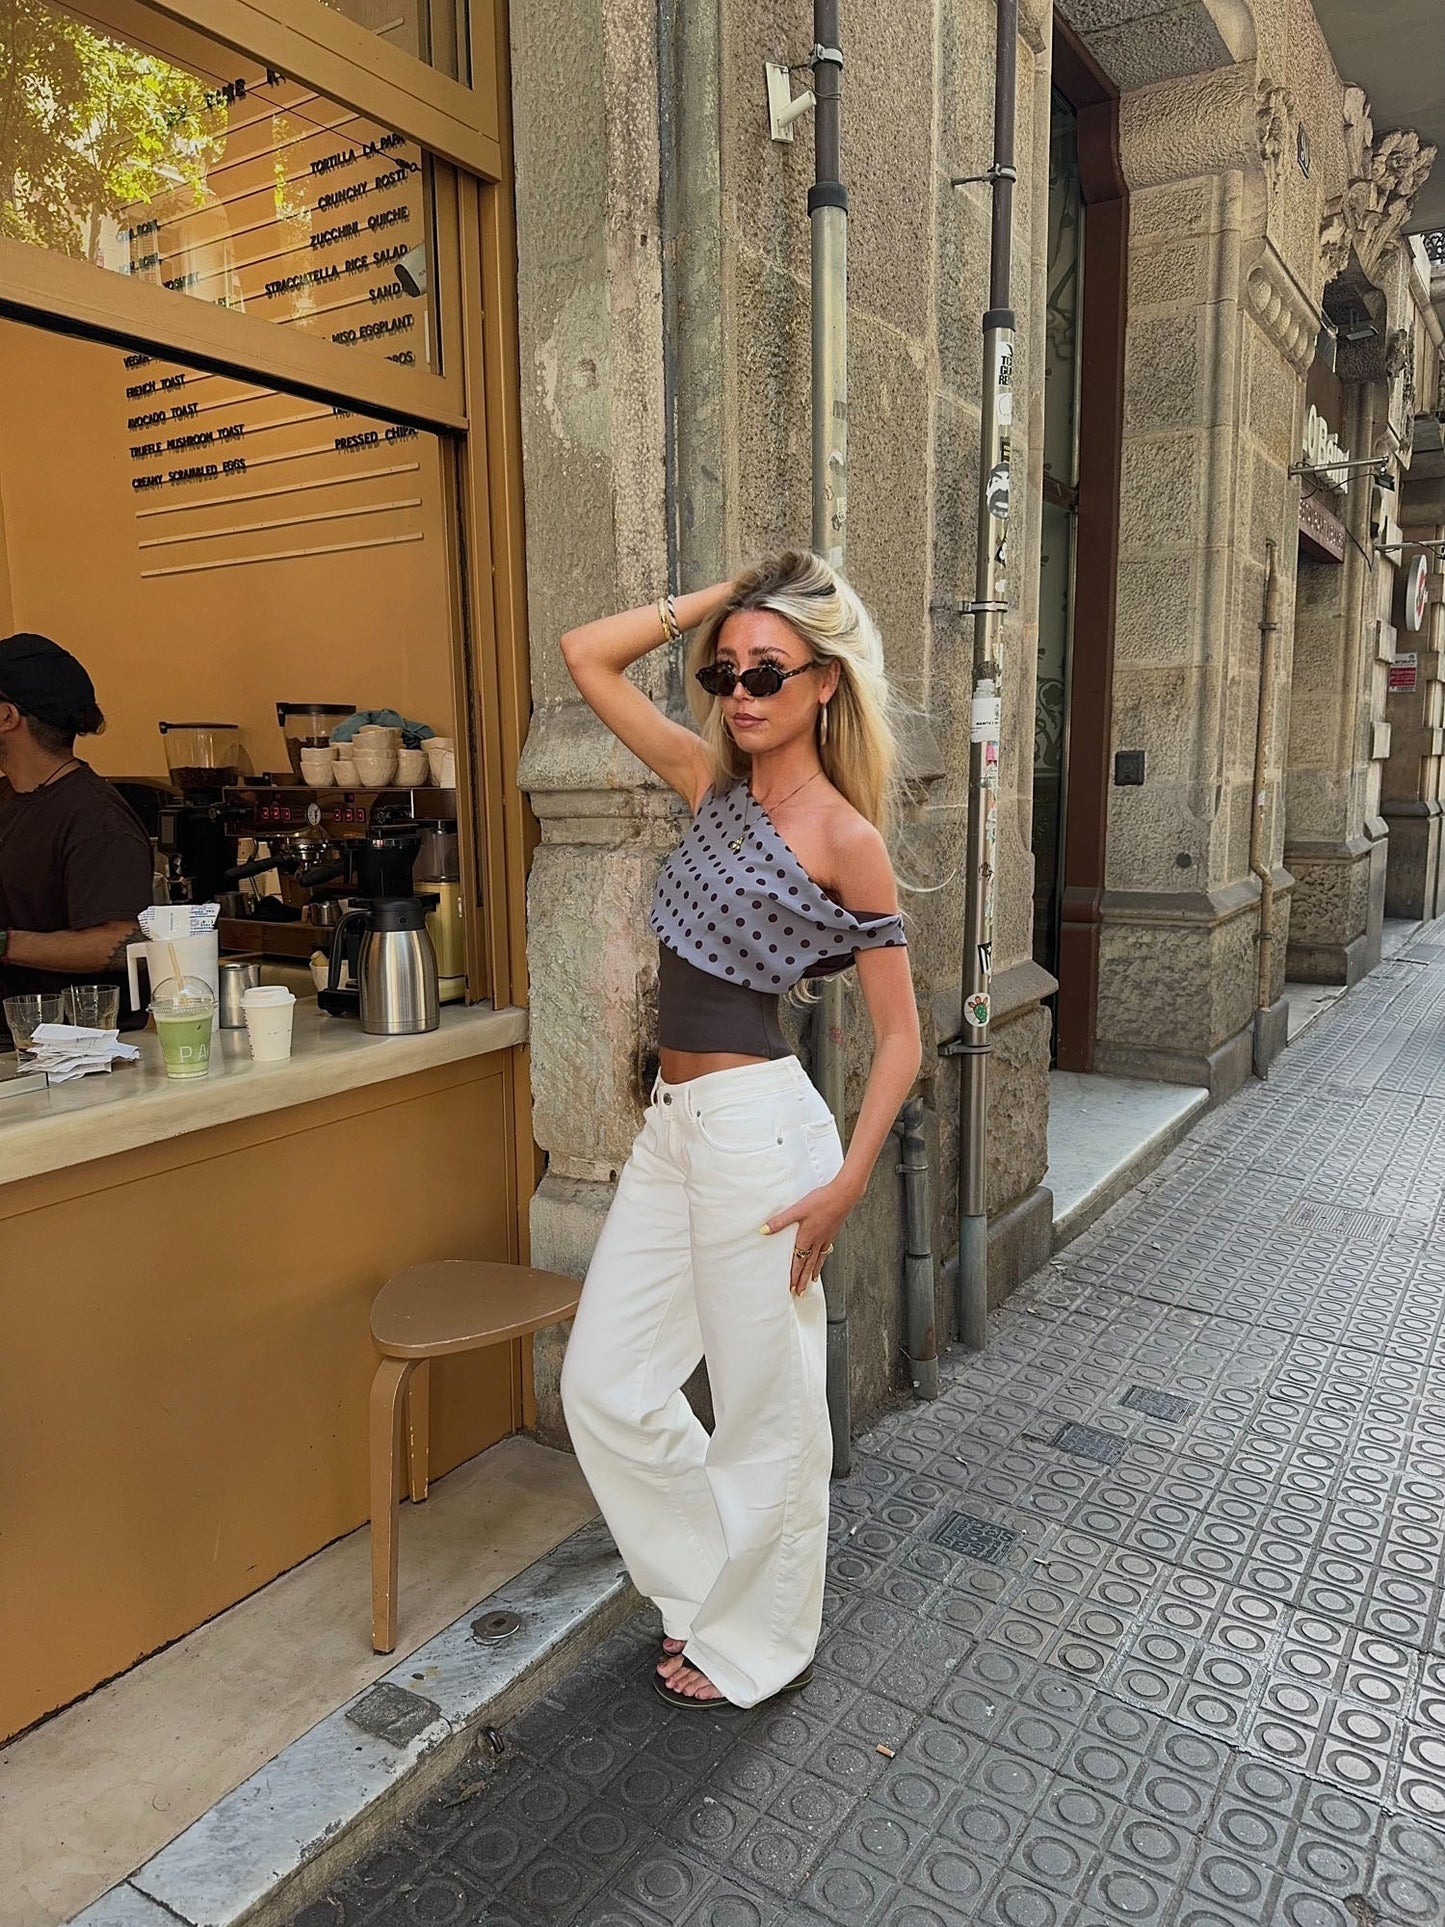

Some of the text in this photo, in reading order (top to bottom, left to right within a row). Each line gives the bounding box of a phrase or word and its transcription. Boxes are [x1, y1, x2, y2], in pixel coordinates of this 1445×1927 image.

[310, 149, 357, 174] TORTILLA
[363, 141, 377, 156] LA
[318, 181, 367, 208] CRUNCHY
[310, 206, 408, 247] ZUCCHINI QUICHE
[265, 244, 407, 295] STRACCIATELLA RICE SALAD
[360, 314, 412, 338] EGGPLANT
[126, 374, 185, 398] FRENCH TOAST
[128, 403, 198, 429] AVOCADO TOAST
[130, 424, 244, 458] TRUFFLE MUSHROOM TOAST
[335, 431, 378, 450] PRESSED
[132, 459, 246, 488] CREAMY SCRAMBLED EGGS
